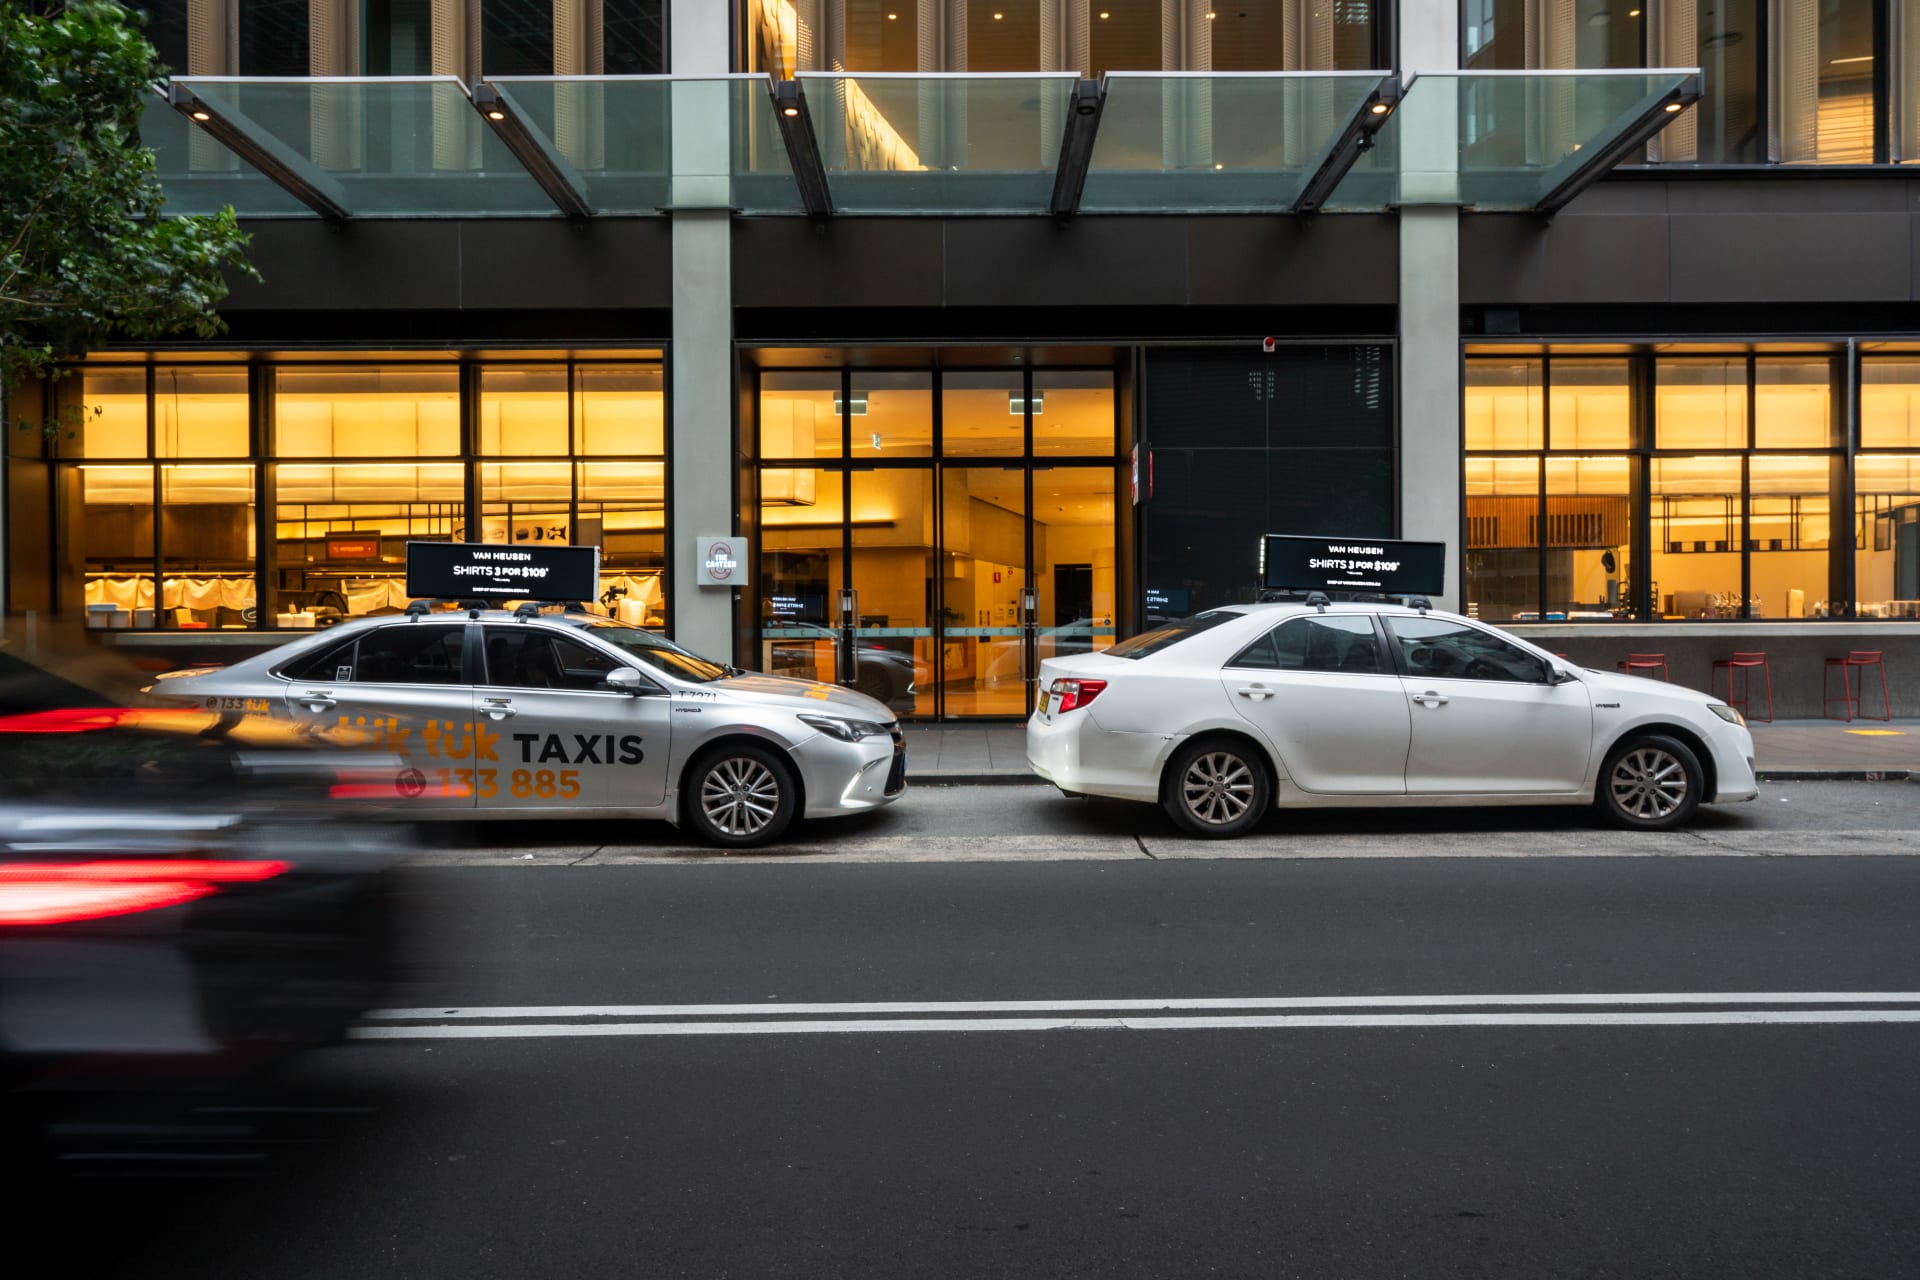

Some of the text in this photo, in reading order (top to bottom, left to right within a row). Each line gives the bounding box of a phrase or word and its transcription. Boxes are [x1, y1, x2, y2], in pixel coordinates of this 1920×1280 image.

[1328, 545, 1384, 555] VAN HEUSEN
[472, 551, 531, 561] VAN HEUSEN
[714, 553, 728, 561] THE
[705, 560, 737, 568] CANTEEN
[1309, 558, 1347, 569] SHIRTS
[1348, 560, 1354, 570] 3
[1355, 561, 1373, 569] FOR
[453, 565, 493, 576] SHIRTS
[494, 567, 501, 576] 3
[502, 567, 521, 576] FOR
[220, 697, 244, 709] 133
[421, 719, 501, 762] tük
[512, 733, 645, 765] TAXIS
[436, 767, 581, 799] 133 885
